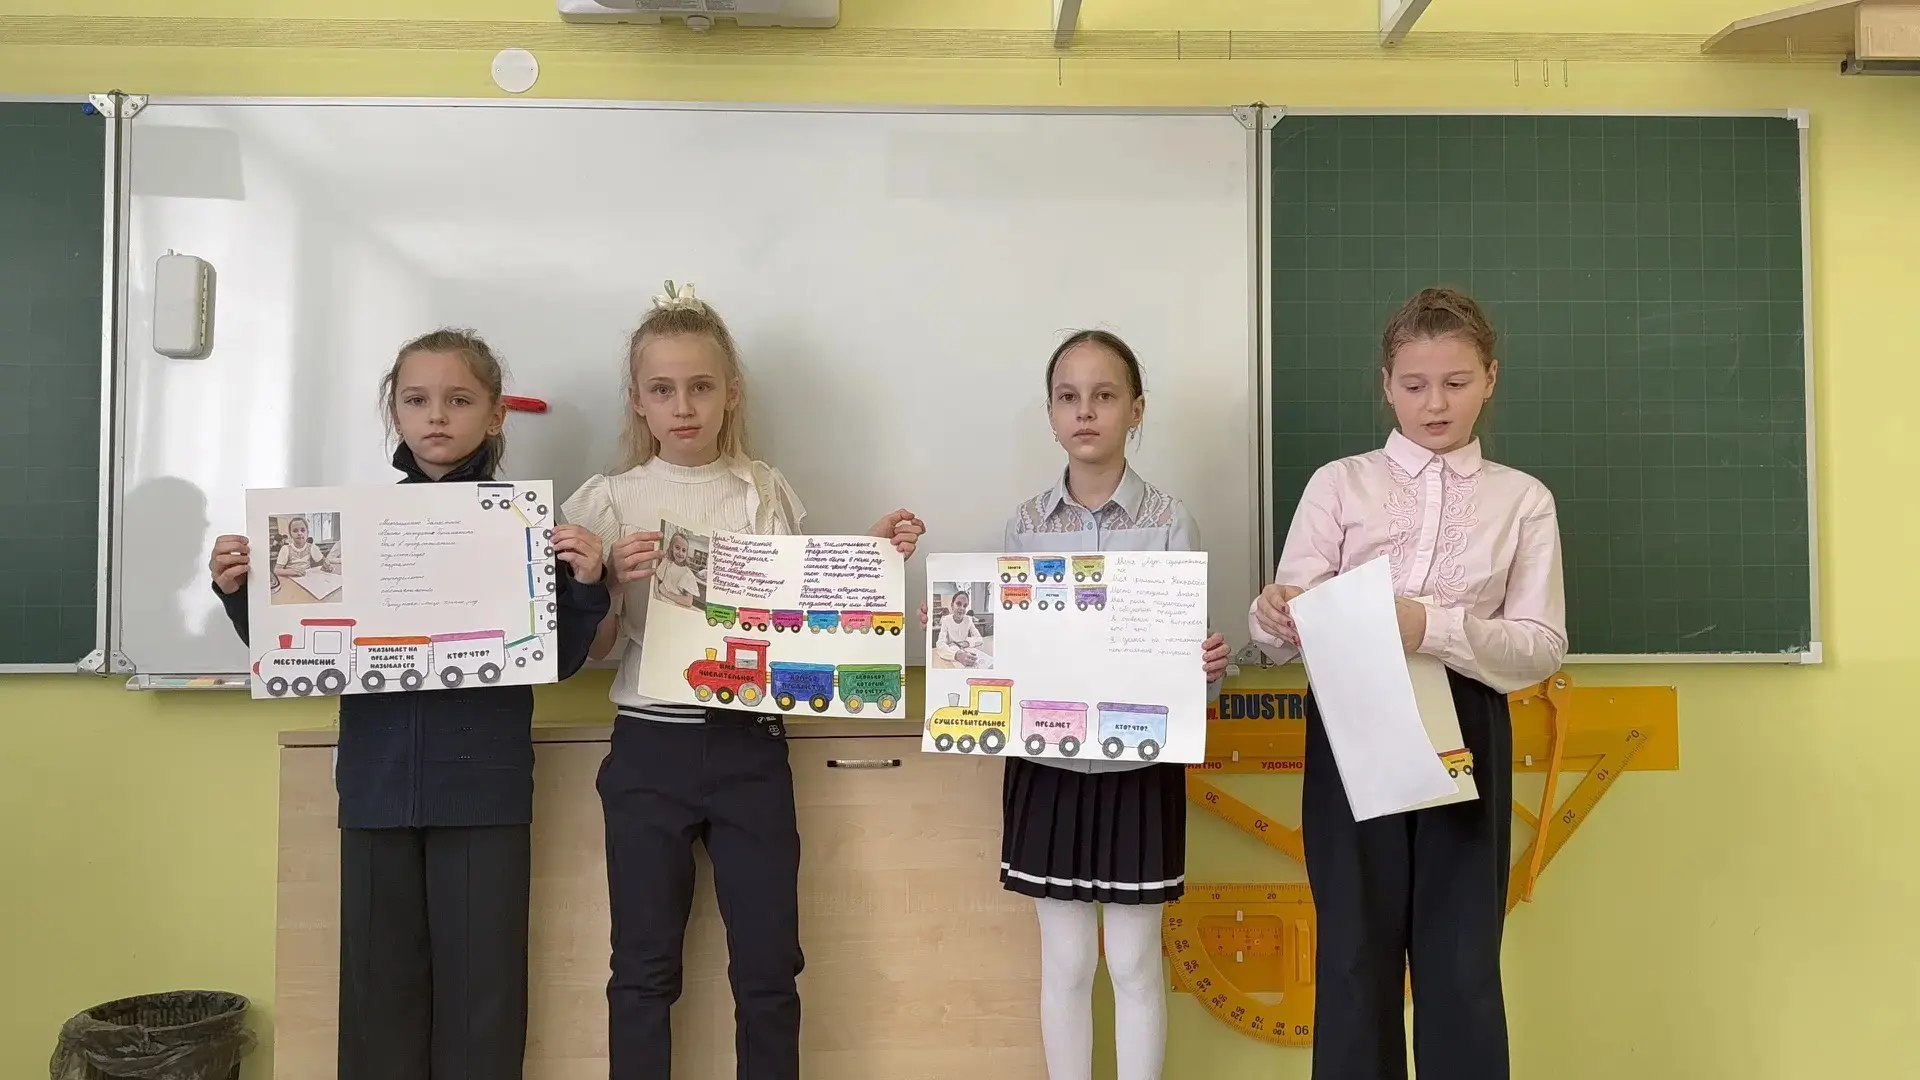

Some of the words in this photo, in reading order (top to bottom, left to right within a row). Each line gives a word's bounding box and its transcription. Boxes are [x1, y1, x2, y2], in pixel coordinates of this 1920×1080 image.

[447, 652, 468, 660] КТО?
[469, 650, 490, 658] ЧТО?
[699, 670, 755, 681] ЧИСЛИТЕЛЬНОЕ
[934, 718, 1006, 727] СУЩЕСТВИТЕЛЬНОЕ
[1035, 721, 1071, 729] ПРЕДМЕТ
[1261, 761, 1303, 770] УДОБНО
[1597, 768, 1609, 781] 10
[1205, 791, 1220, 804] 30
[1562, 809, 1576, 824] 20
[1254, 819, 1269, 832] 20
[1182, 940, 1190, 949] 20
[1191, 960, 1199, 970] 30
[1196, 980, 1207, 992] 140
[1203, 978, 1212, 986] 40
[1212, 997, 1223, 1009] 130
[1218, 993, 1228, 1003] 50
[1235, 1006, 1246, 1015] 60
[1230, 1011, 1243, 1021] 120
[1255, 1016, 1264, 1024] 70
[1251, 1021, 1263, 1031] 110
[1273, 1028, 1285, 1036] 100
